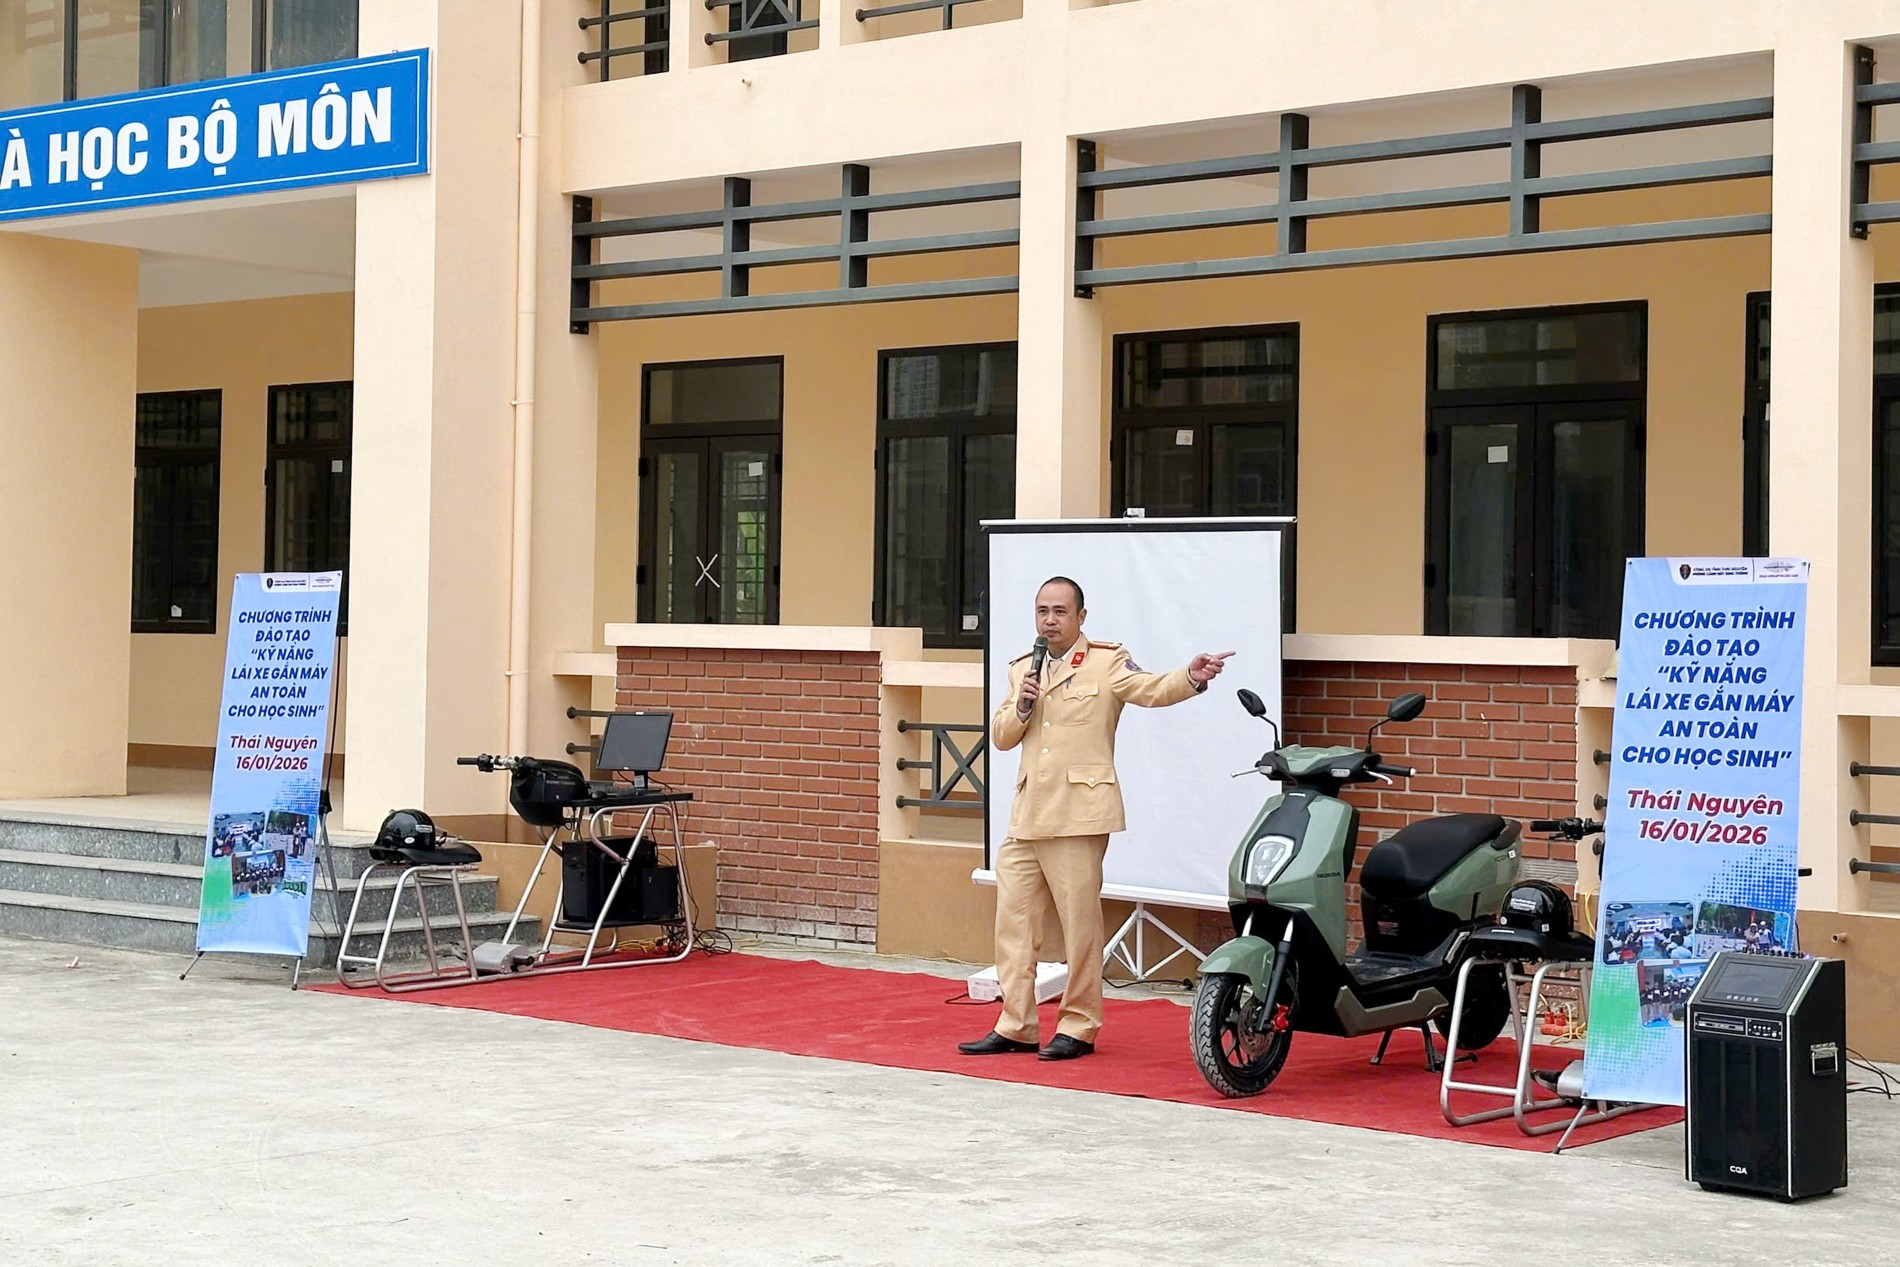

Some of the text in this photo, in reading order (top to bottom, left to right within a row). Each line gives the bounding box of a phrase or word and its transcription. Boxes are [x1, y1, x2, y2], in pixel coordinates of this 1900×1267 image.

[48, 121, 149, 191] HỌC
[167, 98, 237, 177] BỘ
[258, 82, 392, 158] MÔN
[238, 606, 332, 623] CHƯƠNG TRÌNH
[1634, 605, 1796, 629] CHƯƠNG TRÌNH
[255, 626, 311, 645] ĐÀO TẠO
[1664, 633, 1760, 661] ĐÀO TẠO
[276, 645, 314, 661] NĂNG
[231, 661, 328, 680] LÁI XE GẮN MÁY
[1702, 661, 1767, 684] NĂNG
[250, 682, 307, 698] AN TOÀN
[1625, 685, 1795, 712] LÁI XE GẮN MÁY
[228, 704, 257, 717] CHO
[258, 705, 286, 720] HỌC
[1658, 716, 1758, 739] AN TOÀN
[230, 734, 318, 752] Thái Nguyên
[236, 754, 309, 771] 16/01/2026
[1622, 745, 1671, 764] CHO
[1674, 747, 1722, 770] HỌC
[1627, 789, 1783, 818] Thái Nguyên
[1639, 818, 1768, 845] 16/01/2026
